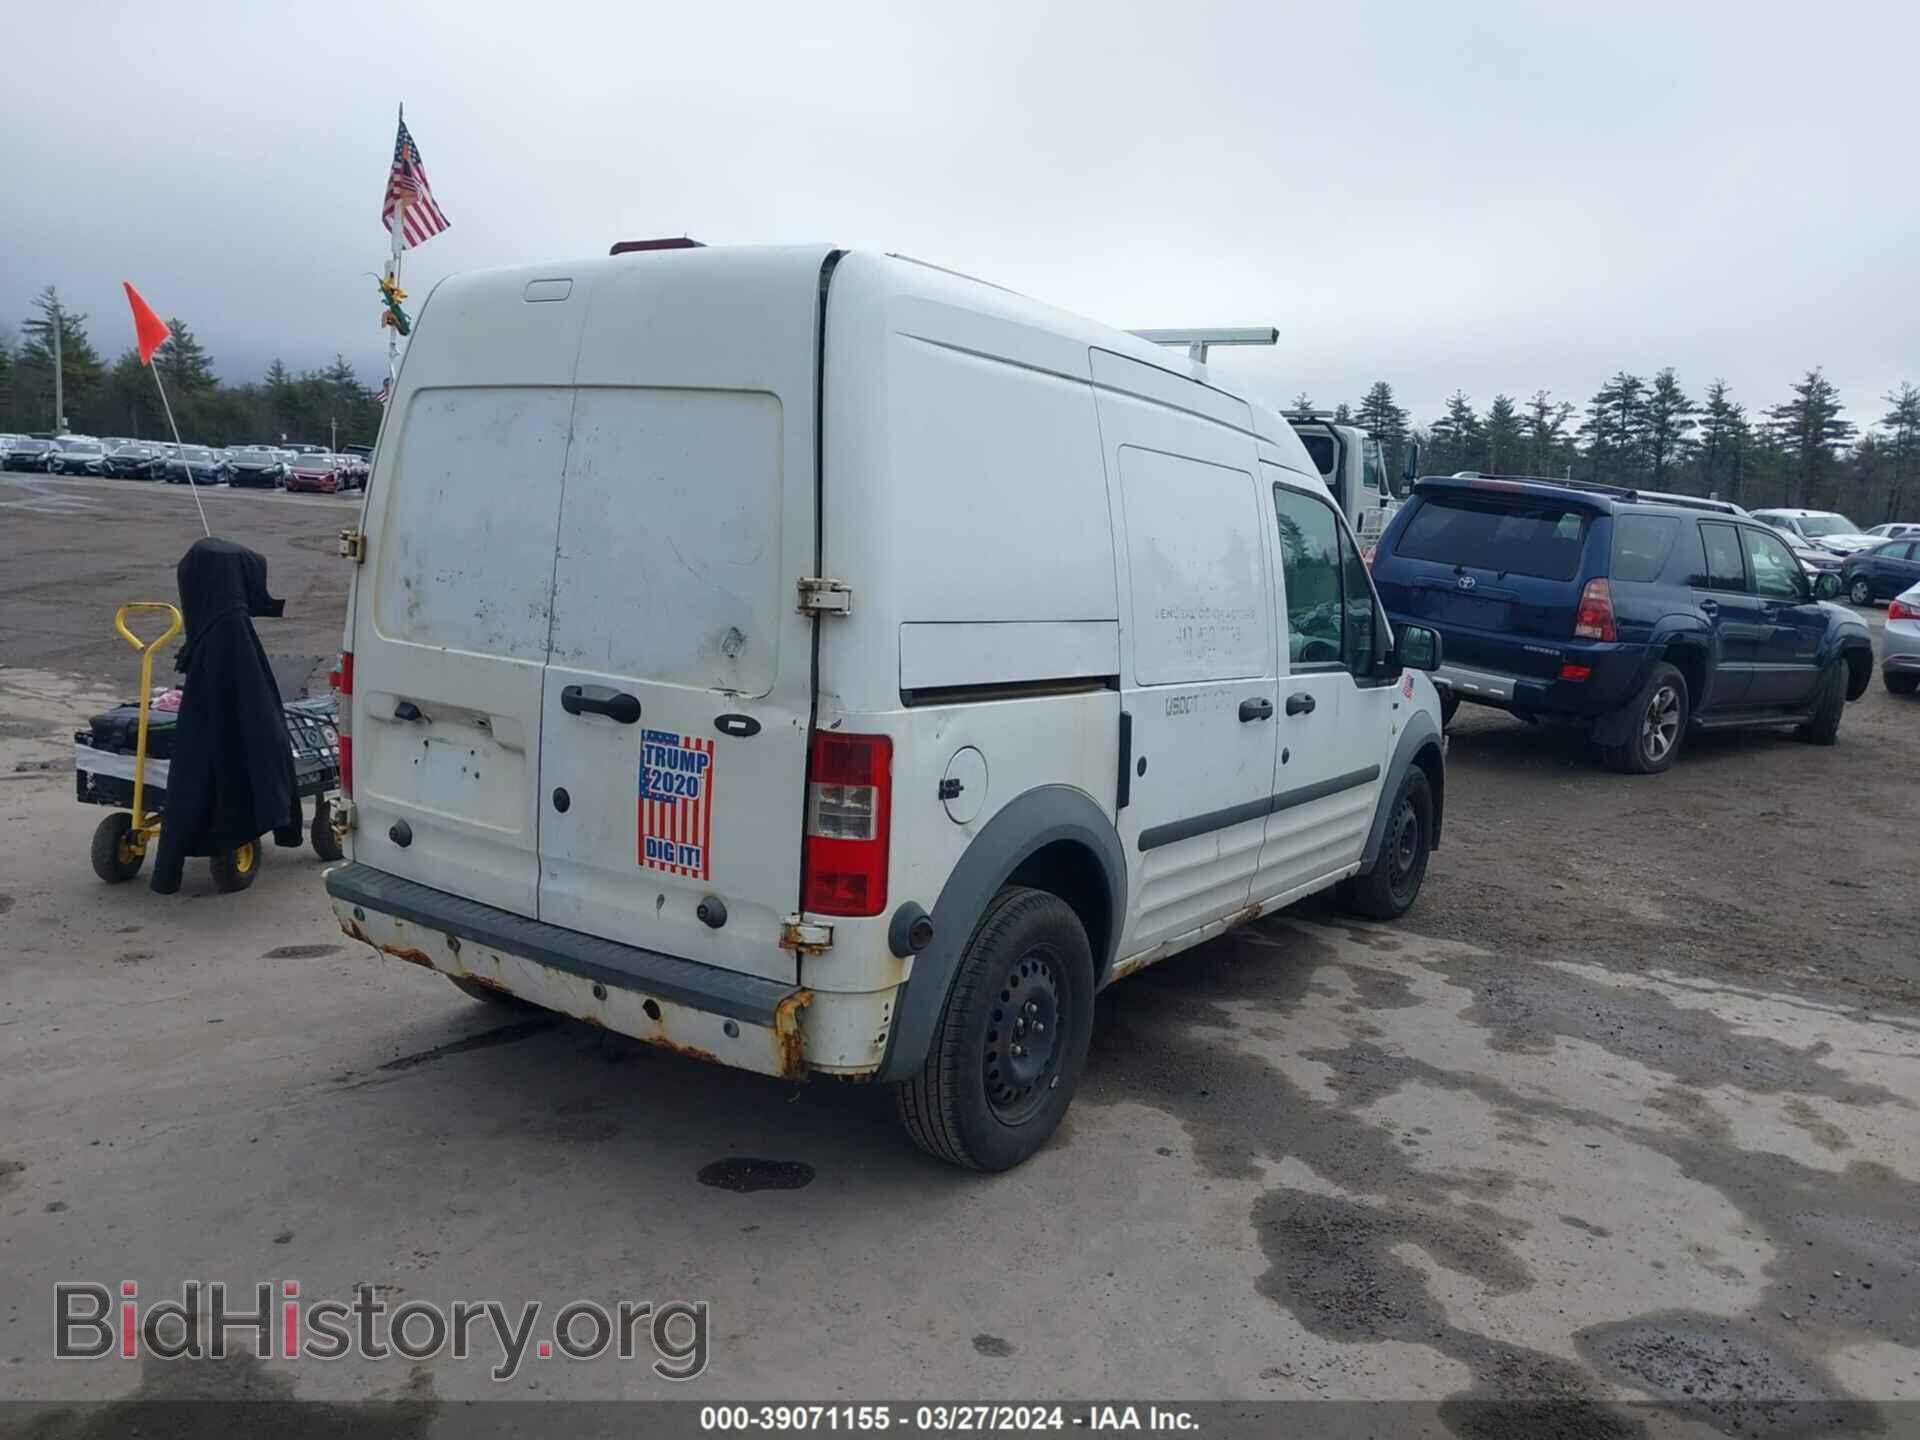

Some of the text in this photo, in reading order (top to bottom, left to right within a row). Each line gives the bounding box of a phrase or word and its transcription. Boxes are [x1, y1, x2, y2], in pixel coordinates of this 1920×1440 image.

[644, 743, 709, 774] TRUMP
[650, 769, 699, 798] 2020
[646, 837, 701, 868] DIG IT!
